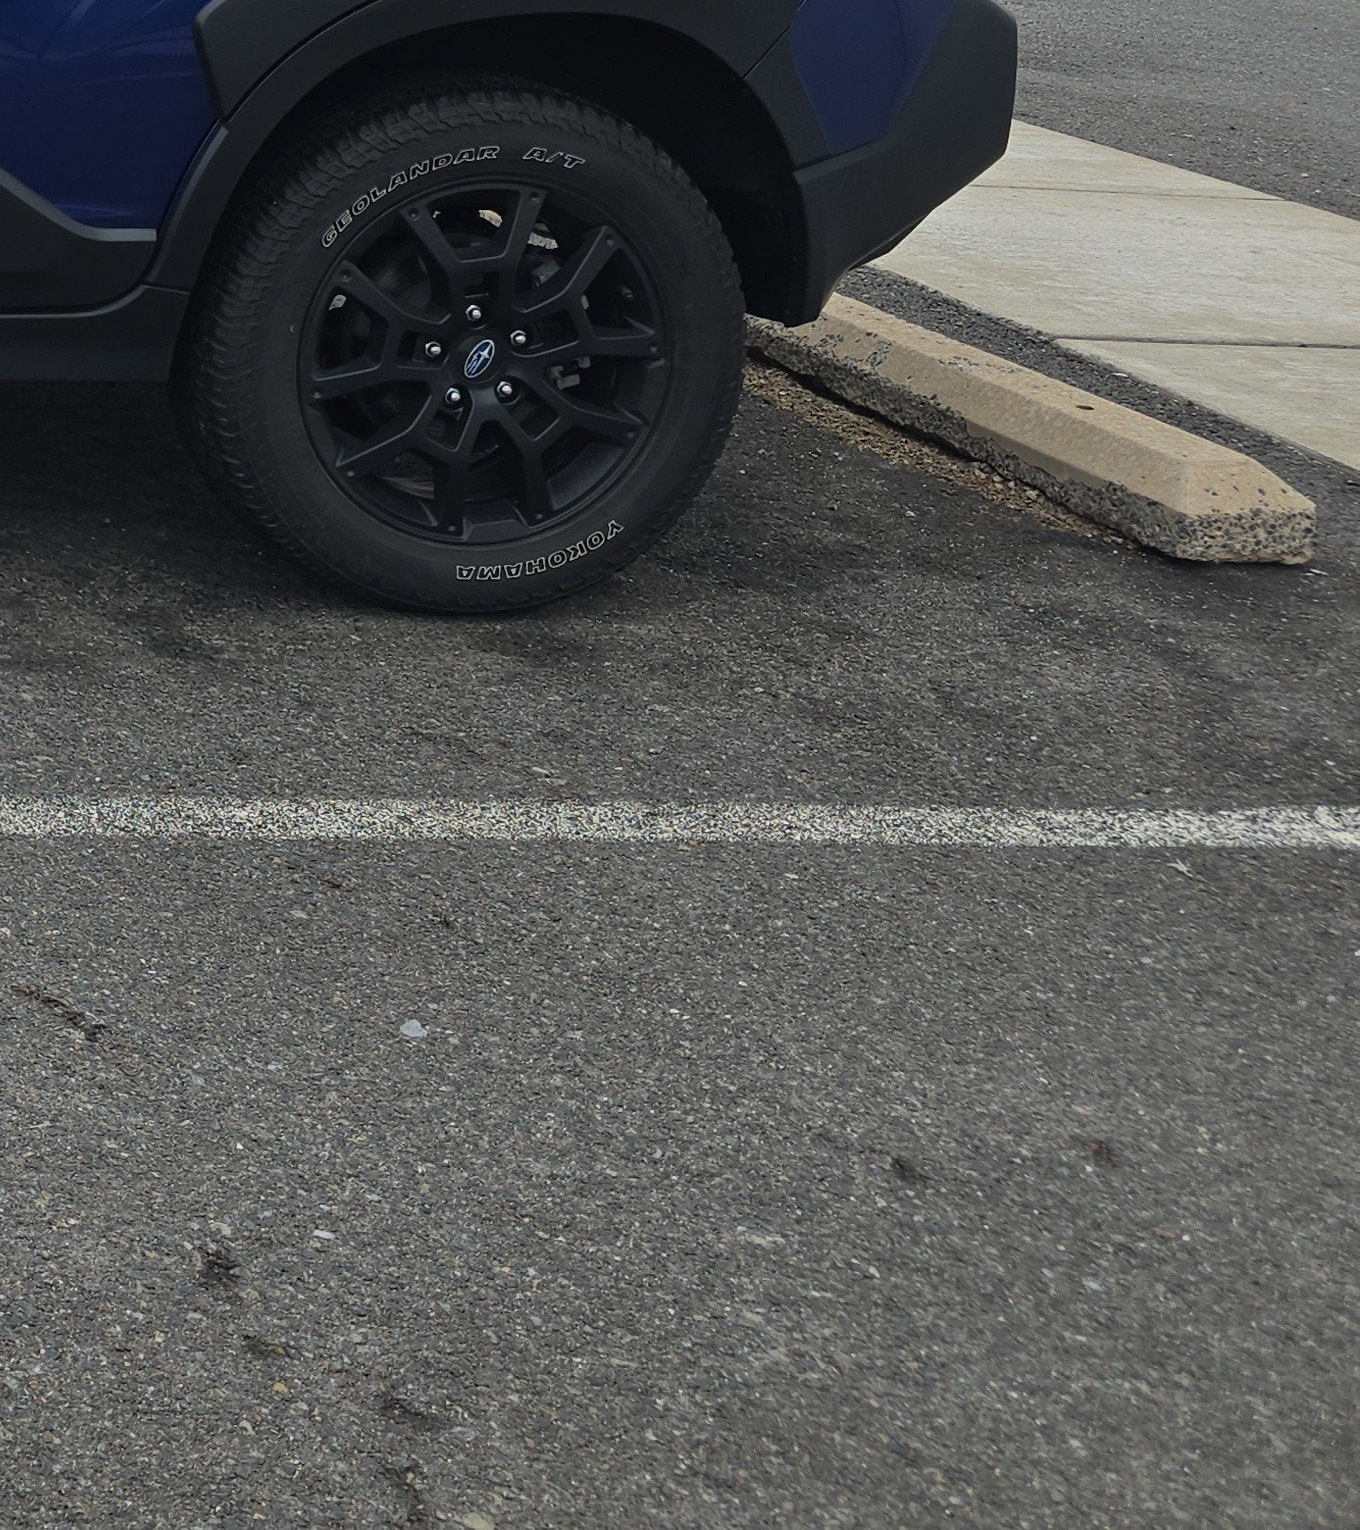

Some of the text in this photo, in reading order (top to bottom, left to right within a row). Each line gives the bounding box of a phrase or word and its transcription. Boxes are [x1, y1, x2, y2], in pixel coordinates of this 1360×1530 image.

[321, 146, 585, 248] GEOLANDAR A/T
[456, 520, 625, 580] YOKOHAMA
